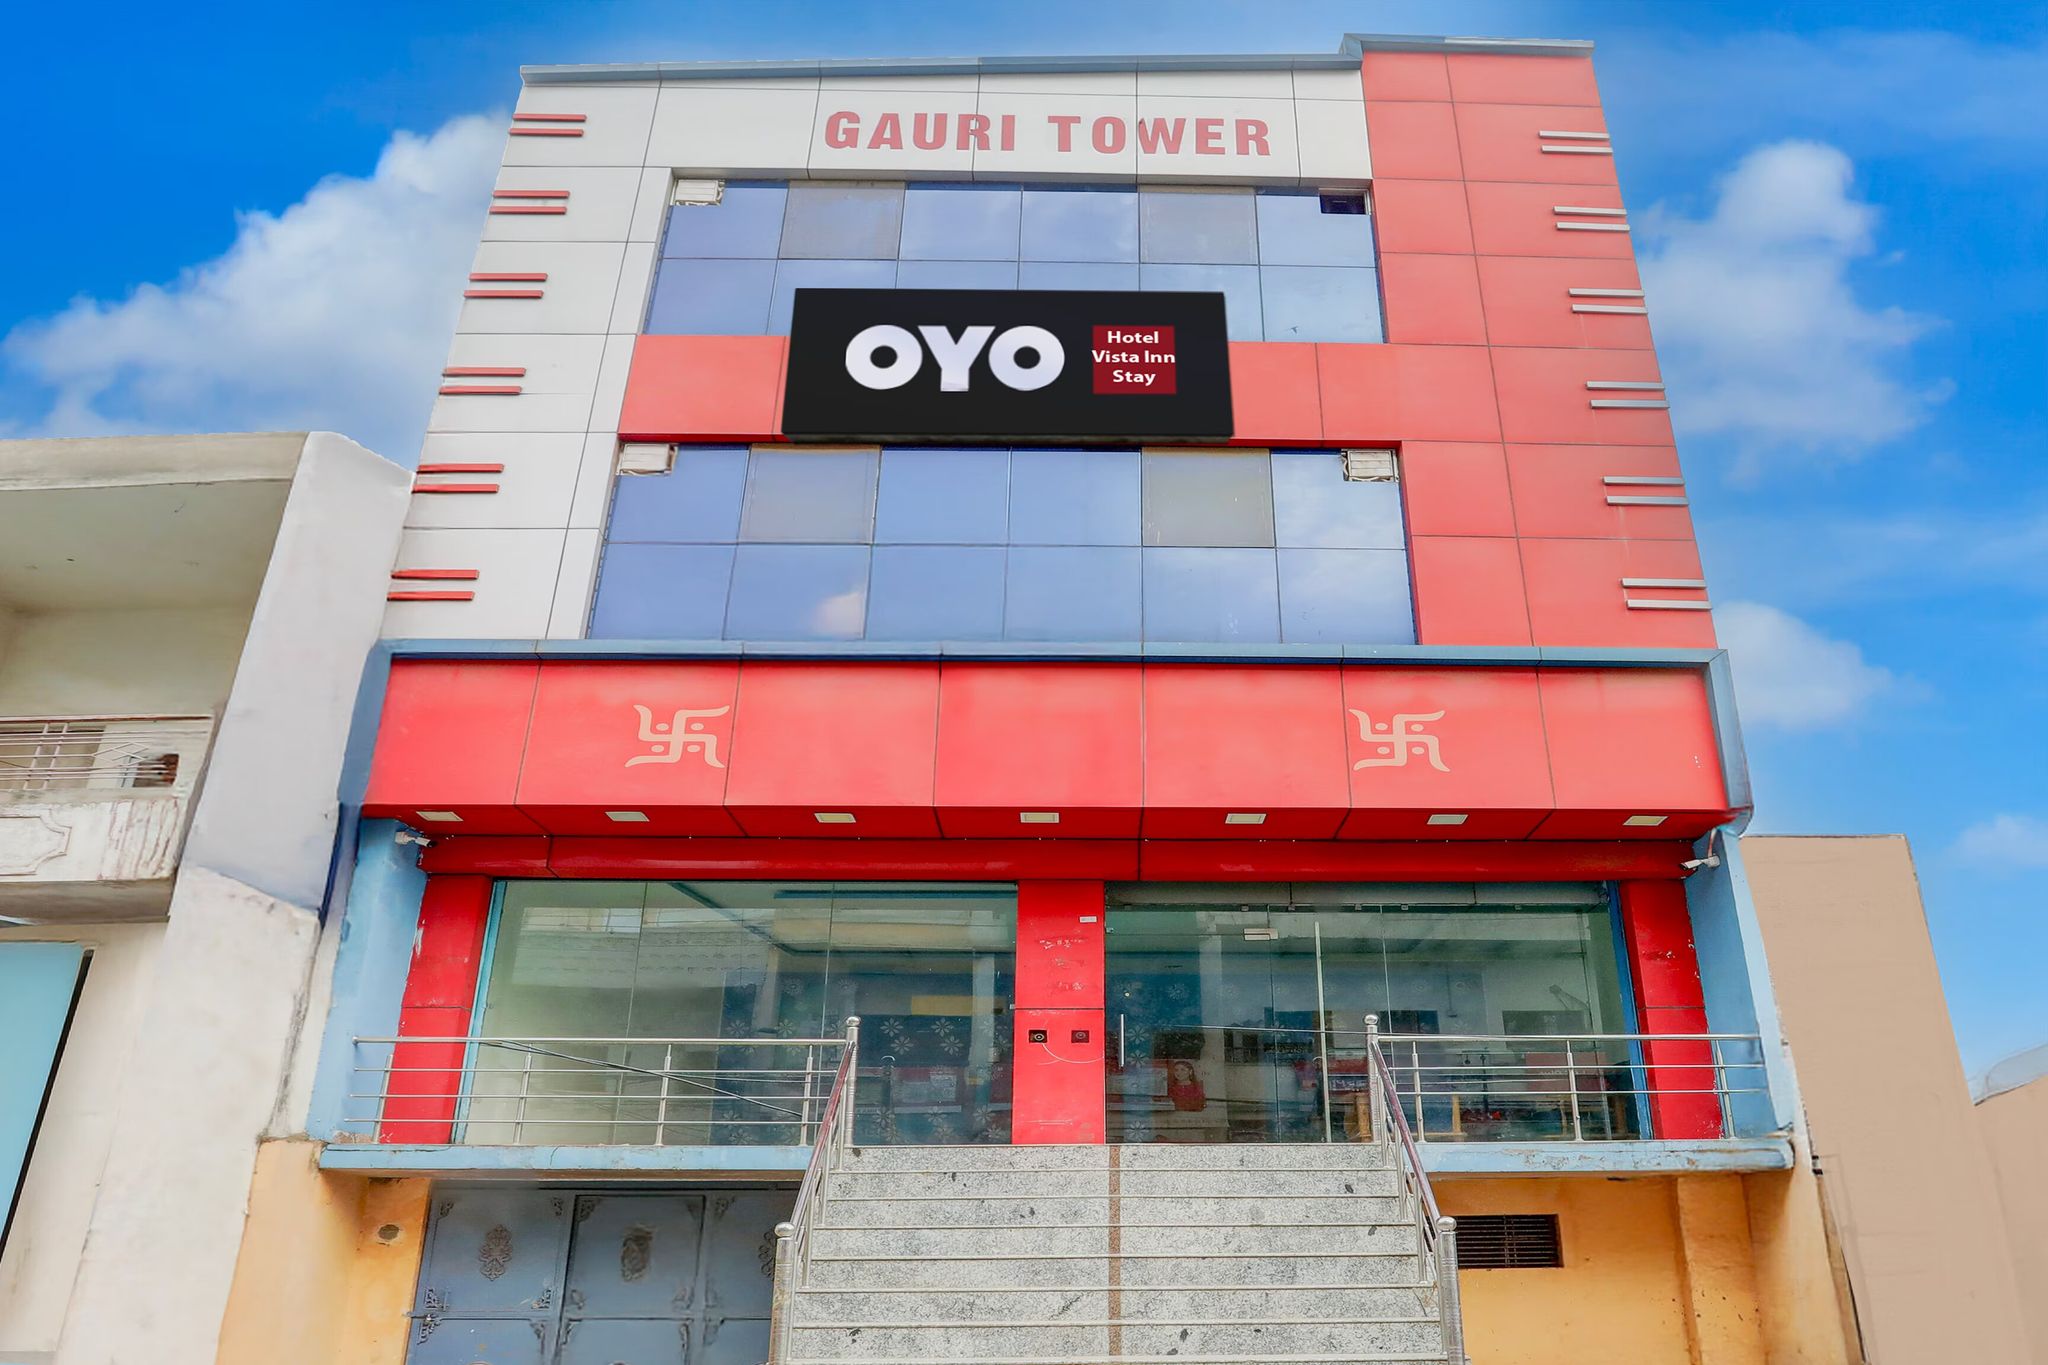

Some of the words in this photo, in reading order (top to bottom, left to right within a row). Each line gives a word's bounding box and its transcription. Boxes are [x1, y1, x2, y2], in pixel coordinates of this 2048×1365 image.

[825, 111, 1015, 151] GAURI
[1048, 115, 1271, 156] TOWER
[1107, 330, 1159, 344] Hotel
[845, 324, 1065, 392] OYO
[1091, 349, 1140, 363] Vista
[1144, 350, 1176, 363] Inn
[1112, 369, 1156, 386] Stay
